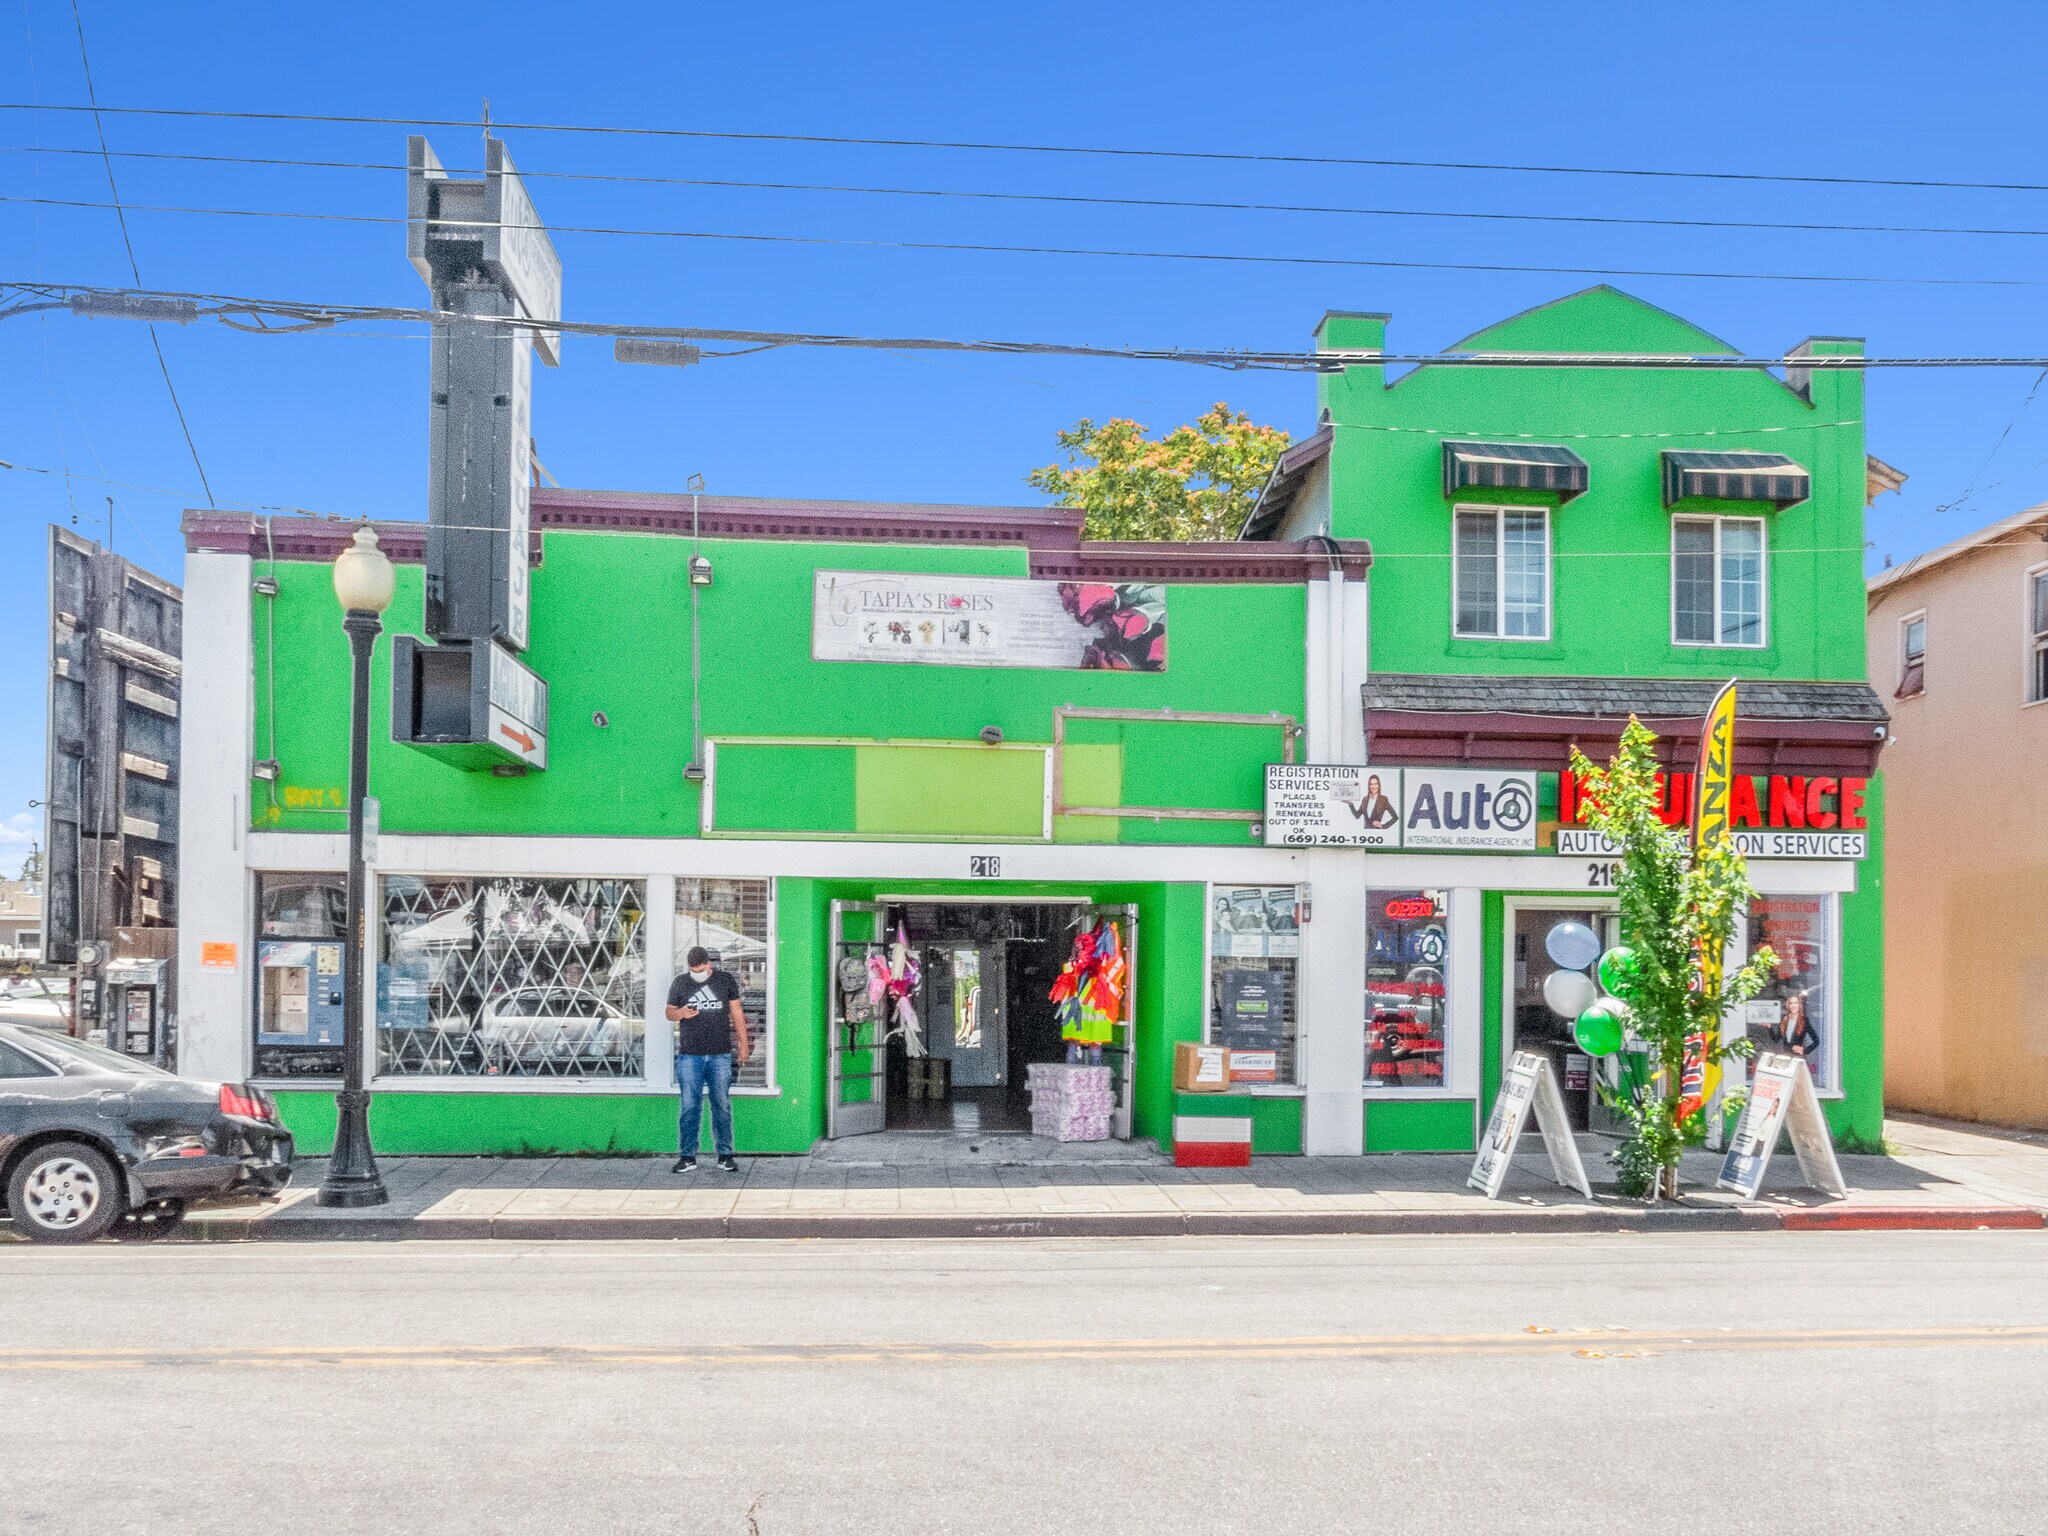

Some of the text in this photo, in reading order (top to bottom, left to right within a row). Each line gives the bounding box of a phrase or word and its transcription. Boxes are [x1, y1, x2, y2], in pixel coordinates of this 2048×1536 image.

[860, 590, 993, 611] TAPIA'S RSES
[1269, 767, 1359, 779] REGISTRATION
[1269, 779, 1330, 791] SERVICES
[1283, 793, 1316, 801] PLACAS
[1560, 769, 1867, 829] IUANCE
[1283, 834, 1384, 845] (669) 240-1900
[1407, 835, 1453, 844] INTERNATIONAL
[1456, 836, 1493, 845] INSURANCE
[1773, 834, 1862, 855] SERVICES
[971, 857, 999, 876] 218
[1385, 901, 1433, 917] OPEN
